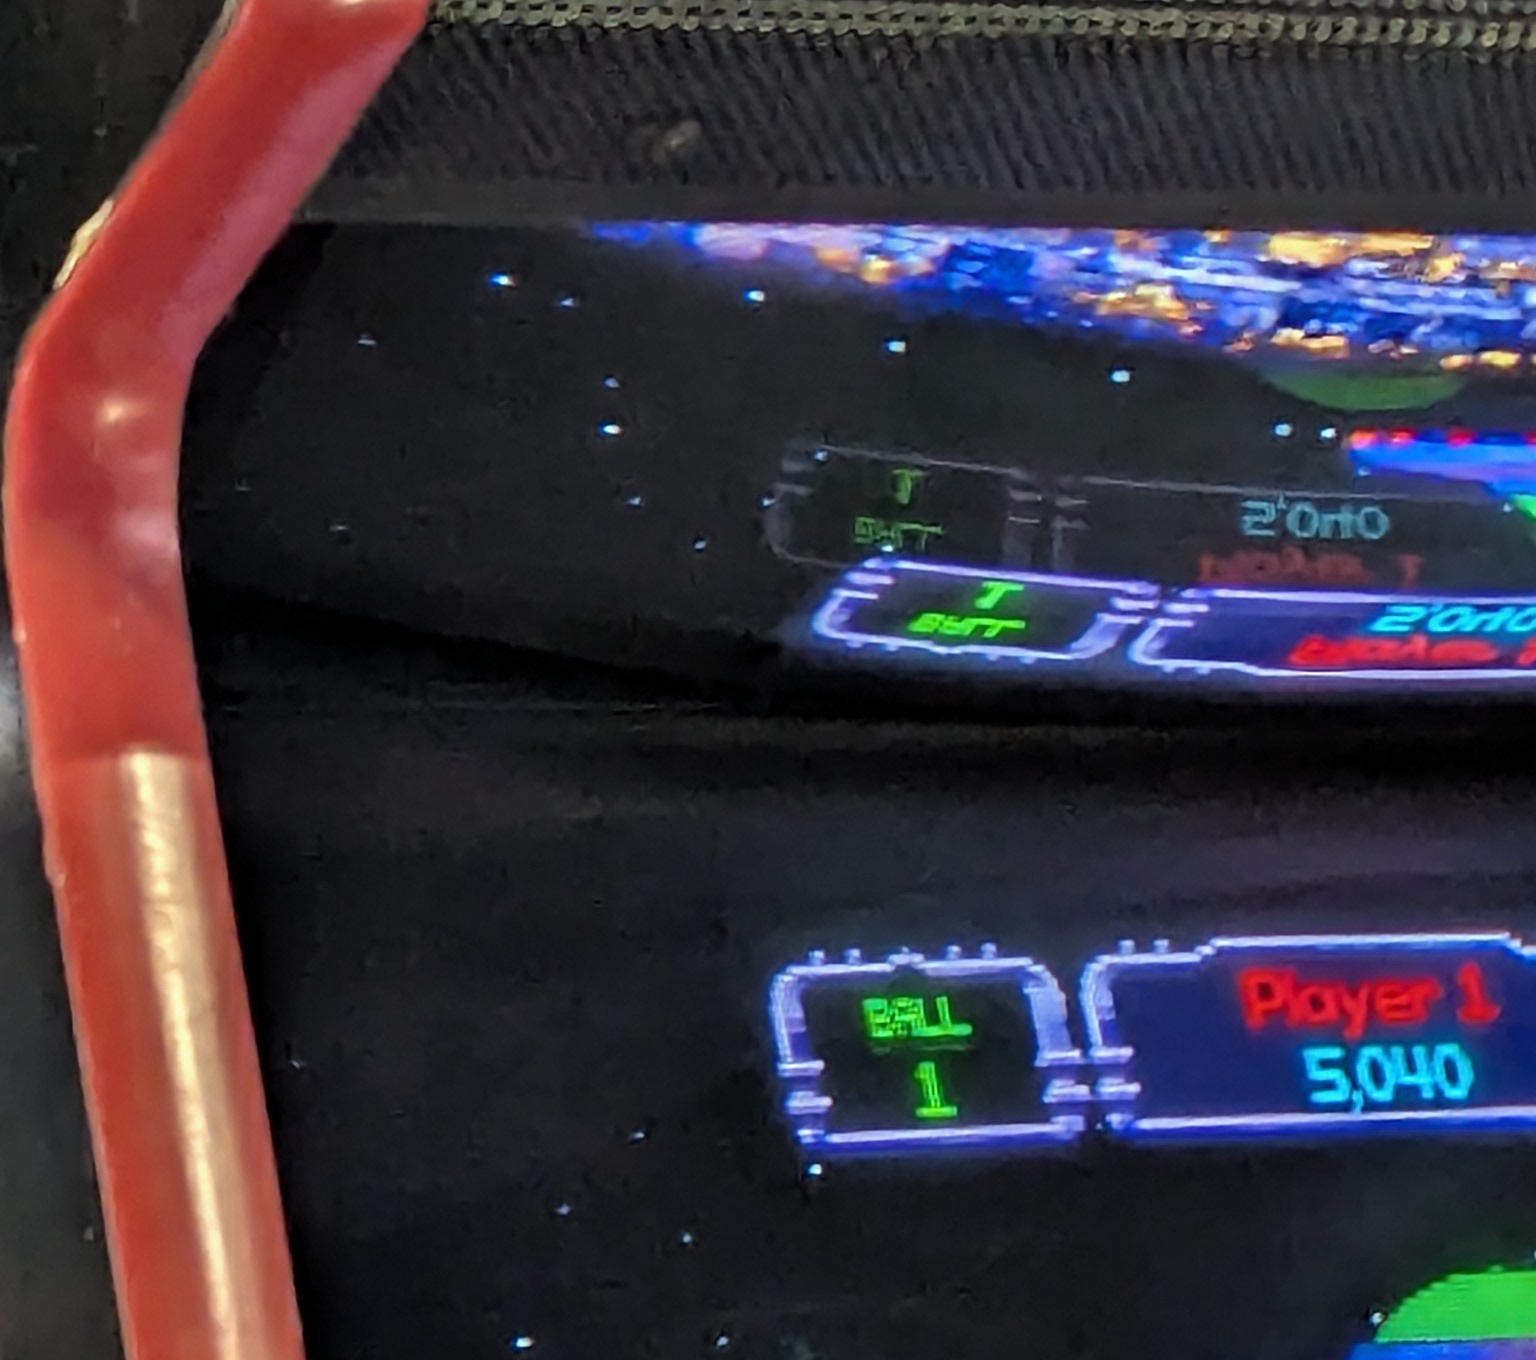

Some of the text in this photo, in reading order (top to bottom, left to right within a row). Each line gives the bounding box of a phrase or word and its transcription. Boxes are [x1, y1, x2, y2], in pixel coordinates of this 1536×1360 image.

[862, 996, 973, 1038] BALL
[1238, 961, 1501, 1041] Player 1
[914, 1060, 958, 1118] 1
[1302, 1043, 1475, 1112] 5,040
